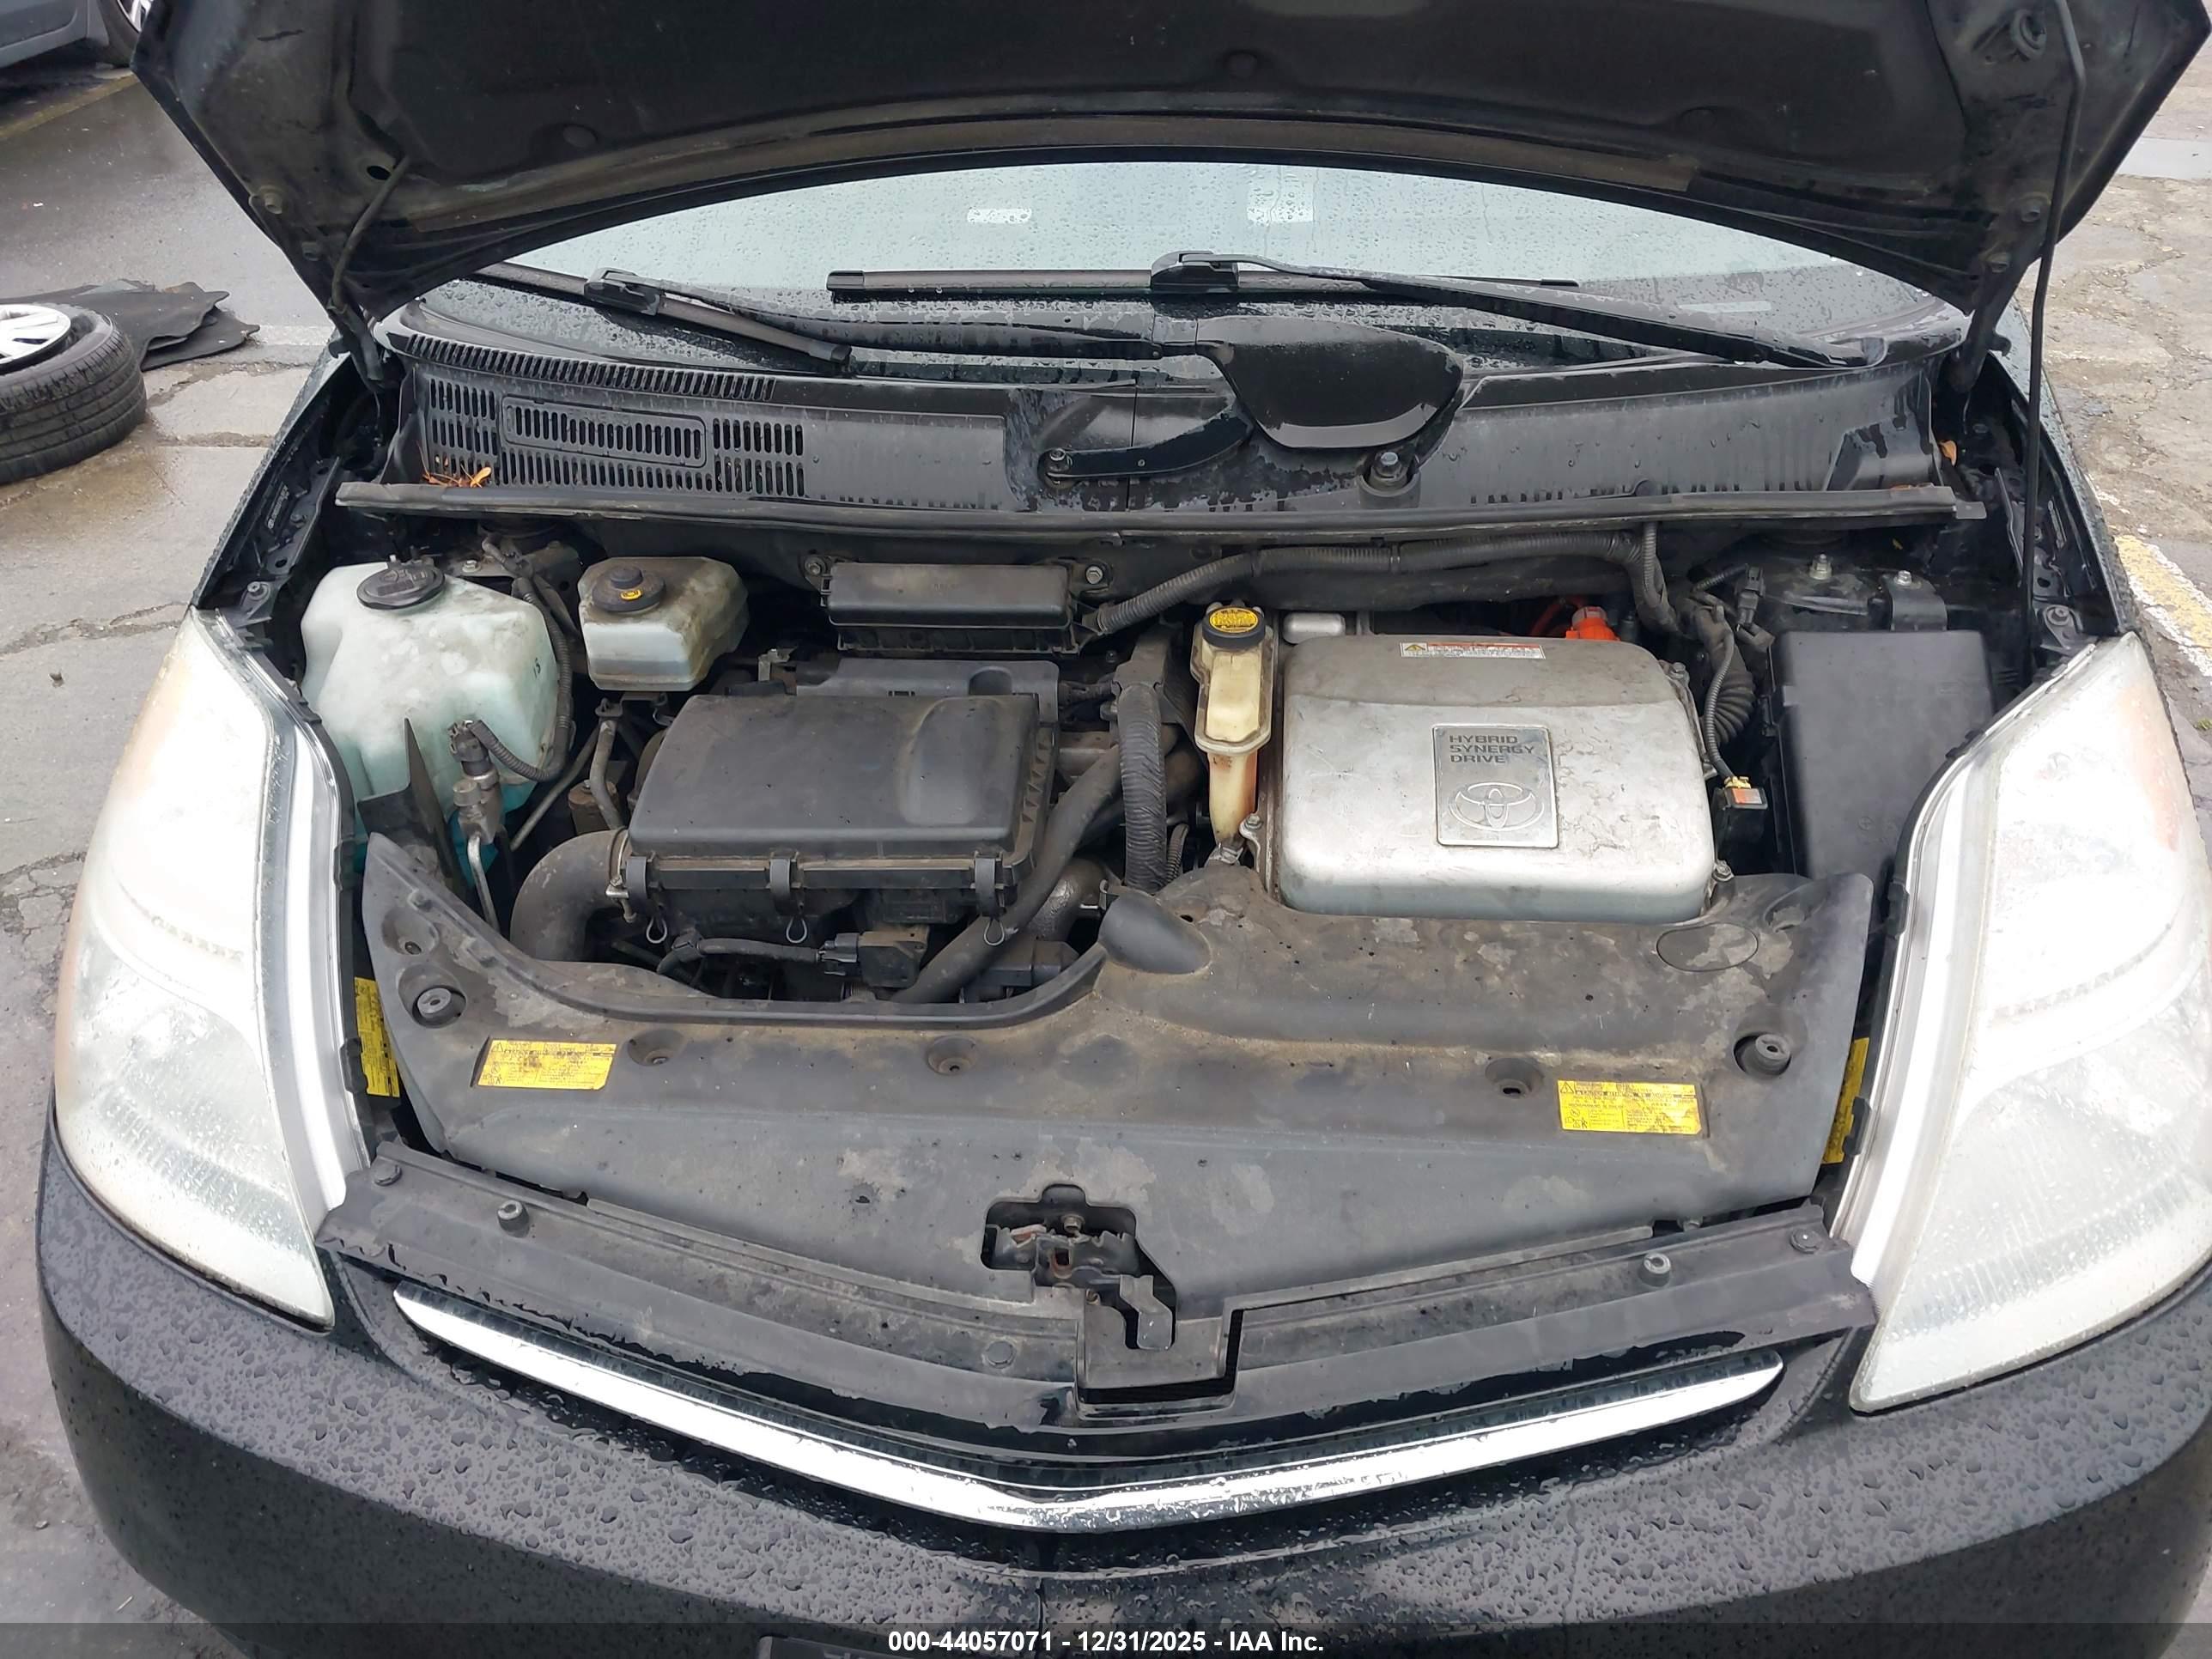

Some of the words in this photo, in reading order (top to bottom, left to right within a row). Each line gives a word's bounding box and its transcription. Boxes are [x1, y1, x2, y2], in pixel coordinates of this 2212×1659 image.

[1449, 735, 1519, 744] HYBRID
[1449, 744, 1535, 754] SYNERGY
[1450, 755, 1506, 763] DRIVE
